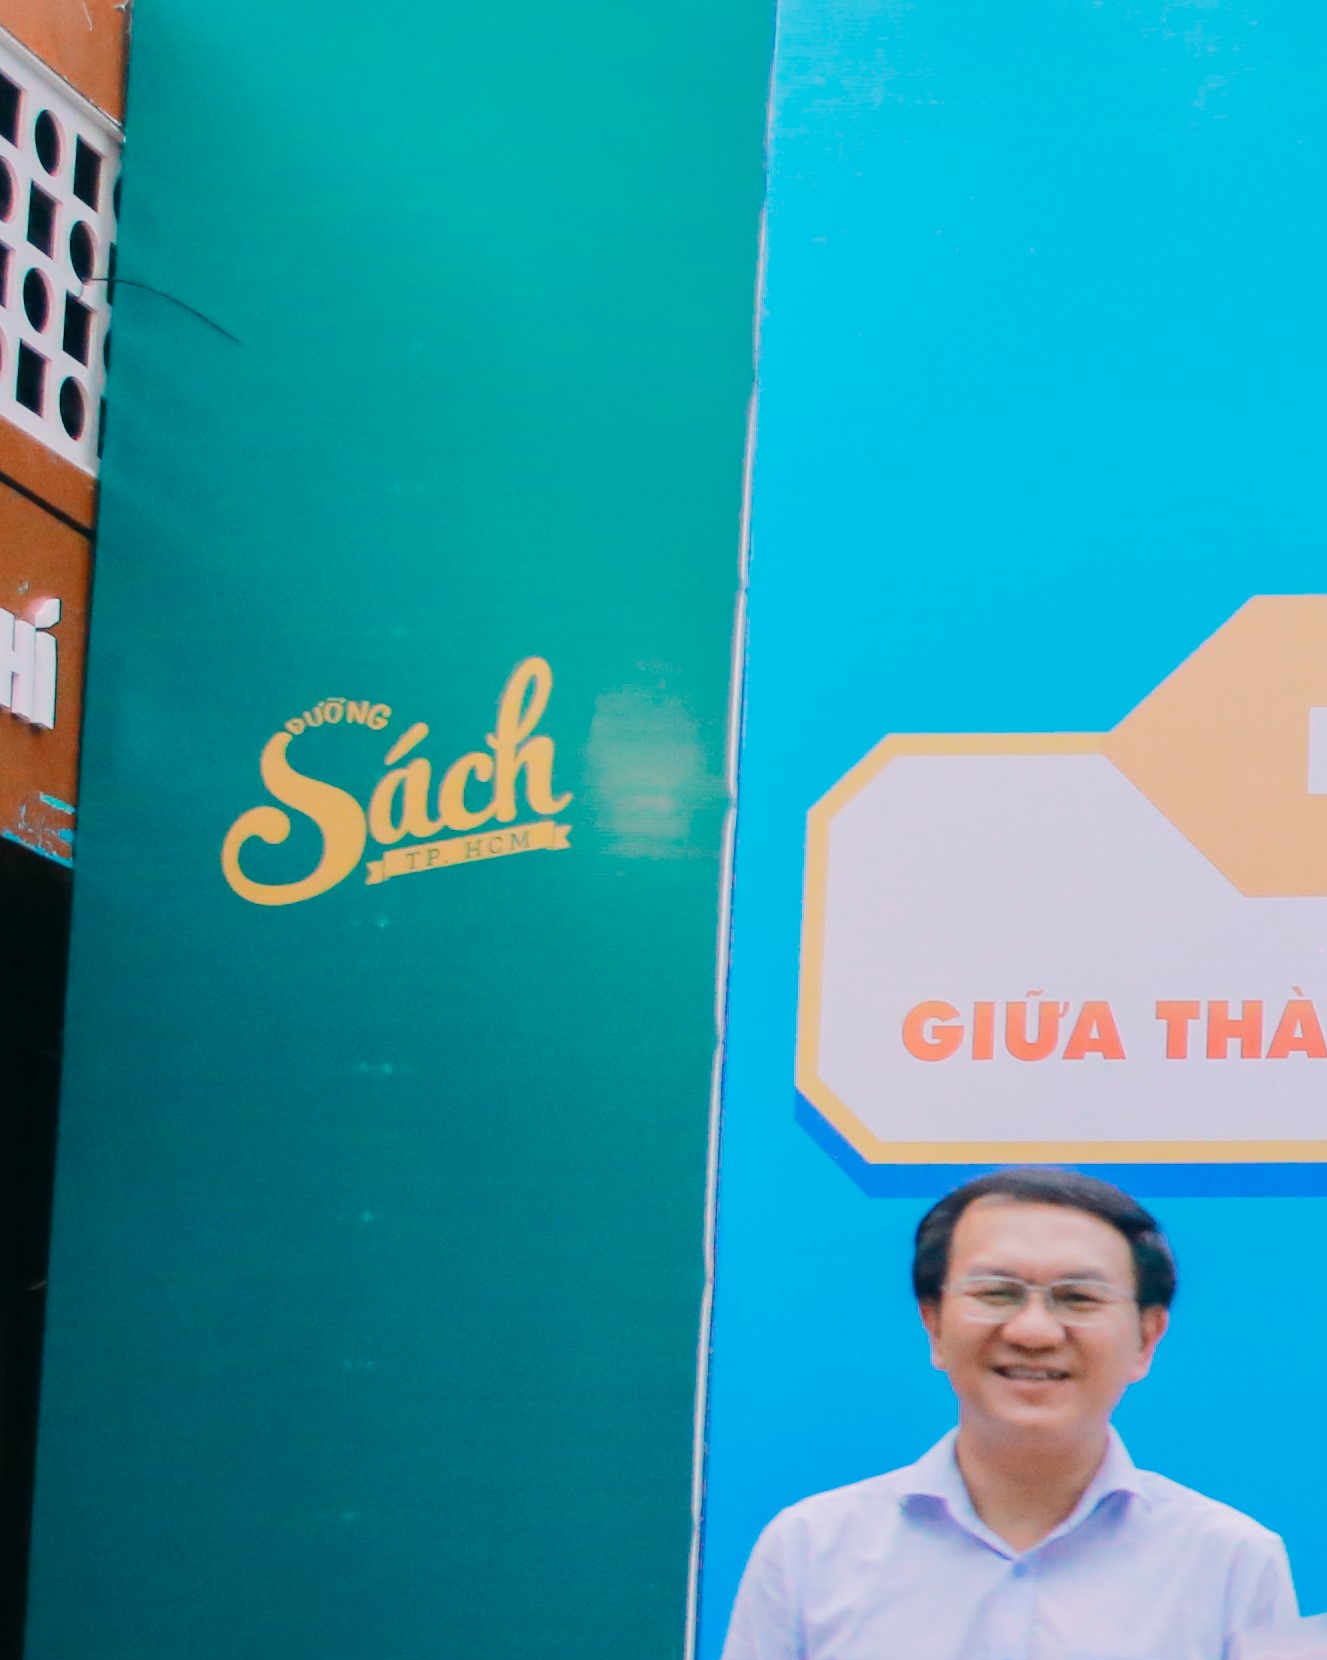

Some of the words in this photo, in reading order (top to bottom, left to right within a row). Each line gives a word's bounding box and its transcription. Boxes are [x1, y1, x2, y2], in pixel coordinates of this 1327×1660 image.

[221, 656, 573, 906] Sách
[464, 831, 531, 860] HCM
[901, 988, 1126, 1061] GIỮA
